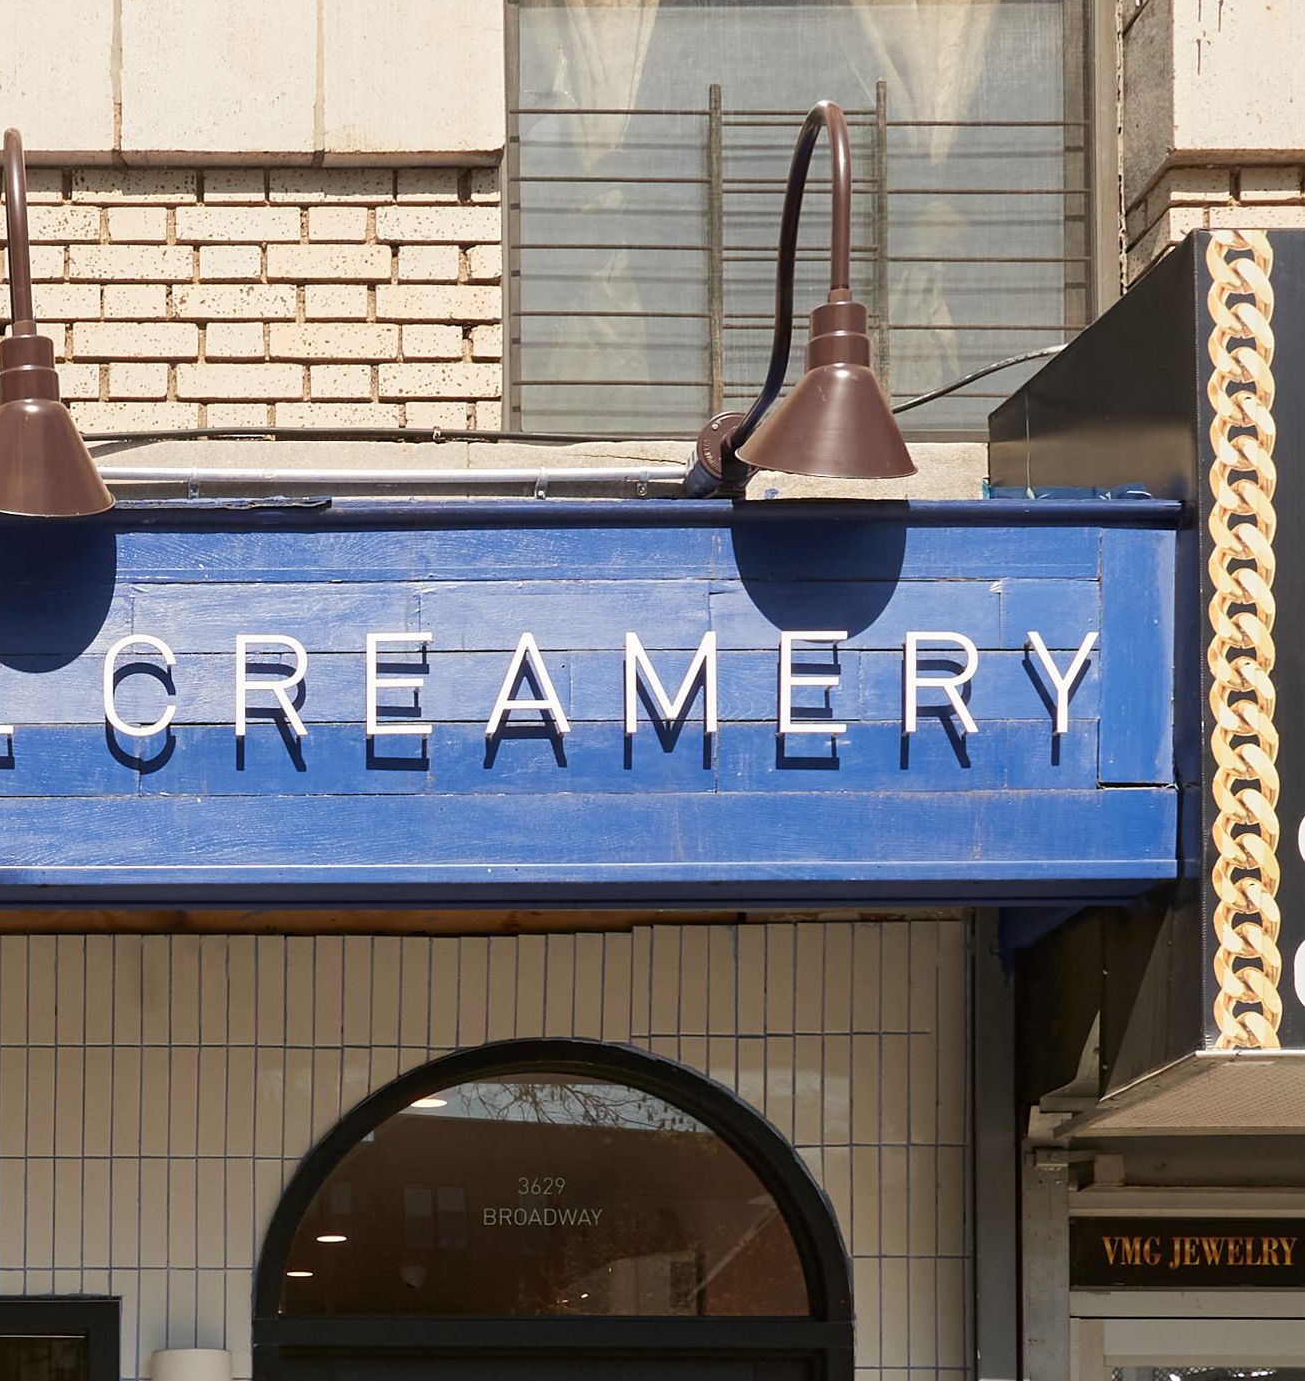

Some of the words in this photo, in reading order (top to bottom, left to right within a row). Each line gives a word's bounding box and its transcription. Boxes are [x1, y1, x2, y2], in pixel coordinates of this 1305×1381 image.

[103, 630, 1100, 737] CREAMERY
[518, 1177, 567, 1196] 3629
[483, 1208, 604, 1227] BROADWAY
[1101, 1236, 1162, 1267] VMG
[1169, 1236, 1298, 1270] JEWELRY
